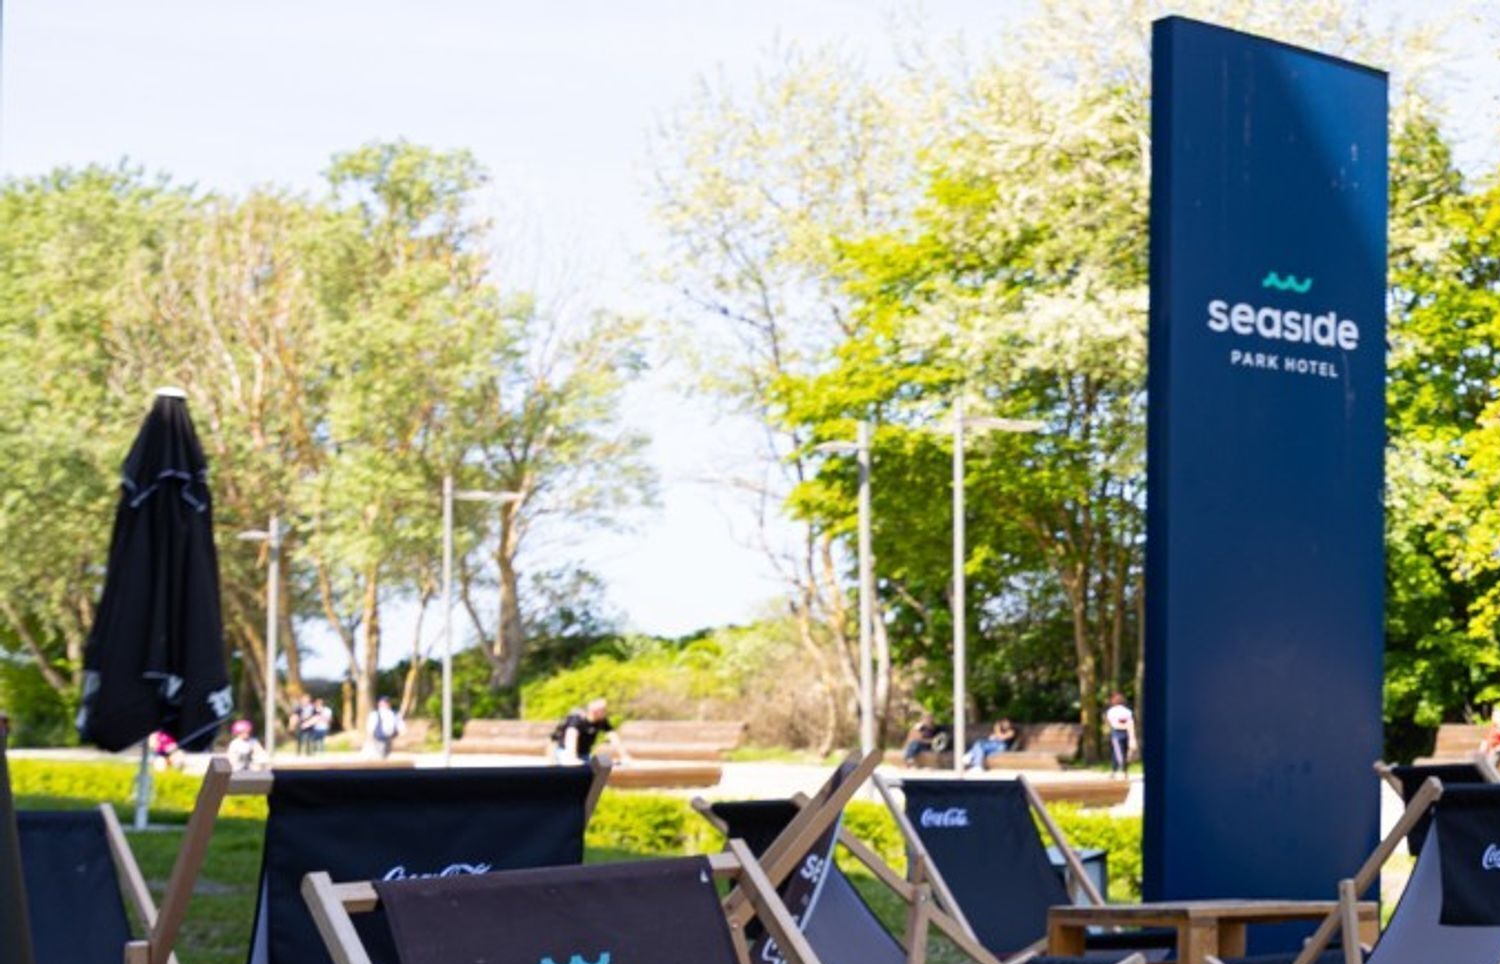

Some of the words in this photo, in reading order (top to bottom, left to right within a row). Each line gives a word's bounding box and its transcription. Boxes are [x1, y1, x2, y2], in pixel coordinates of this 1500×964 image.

[1207, 300, 1360, 350] seaside
[1231, 350, 1279, 370] PARK
[1284, 358, 1339, 378] HOTEL
